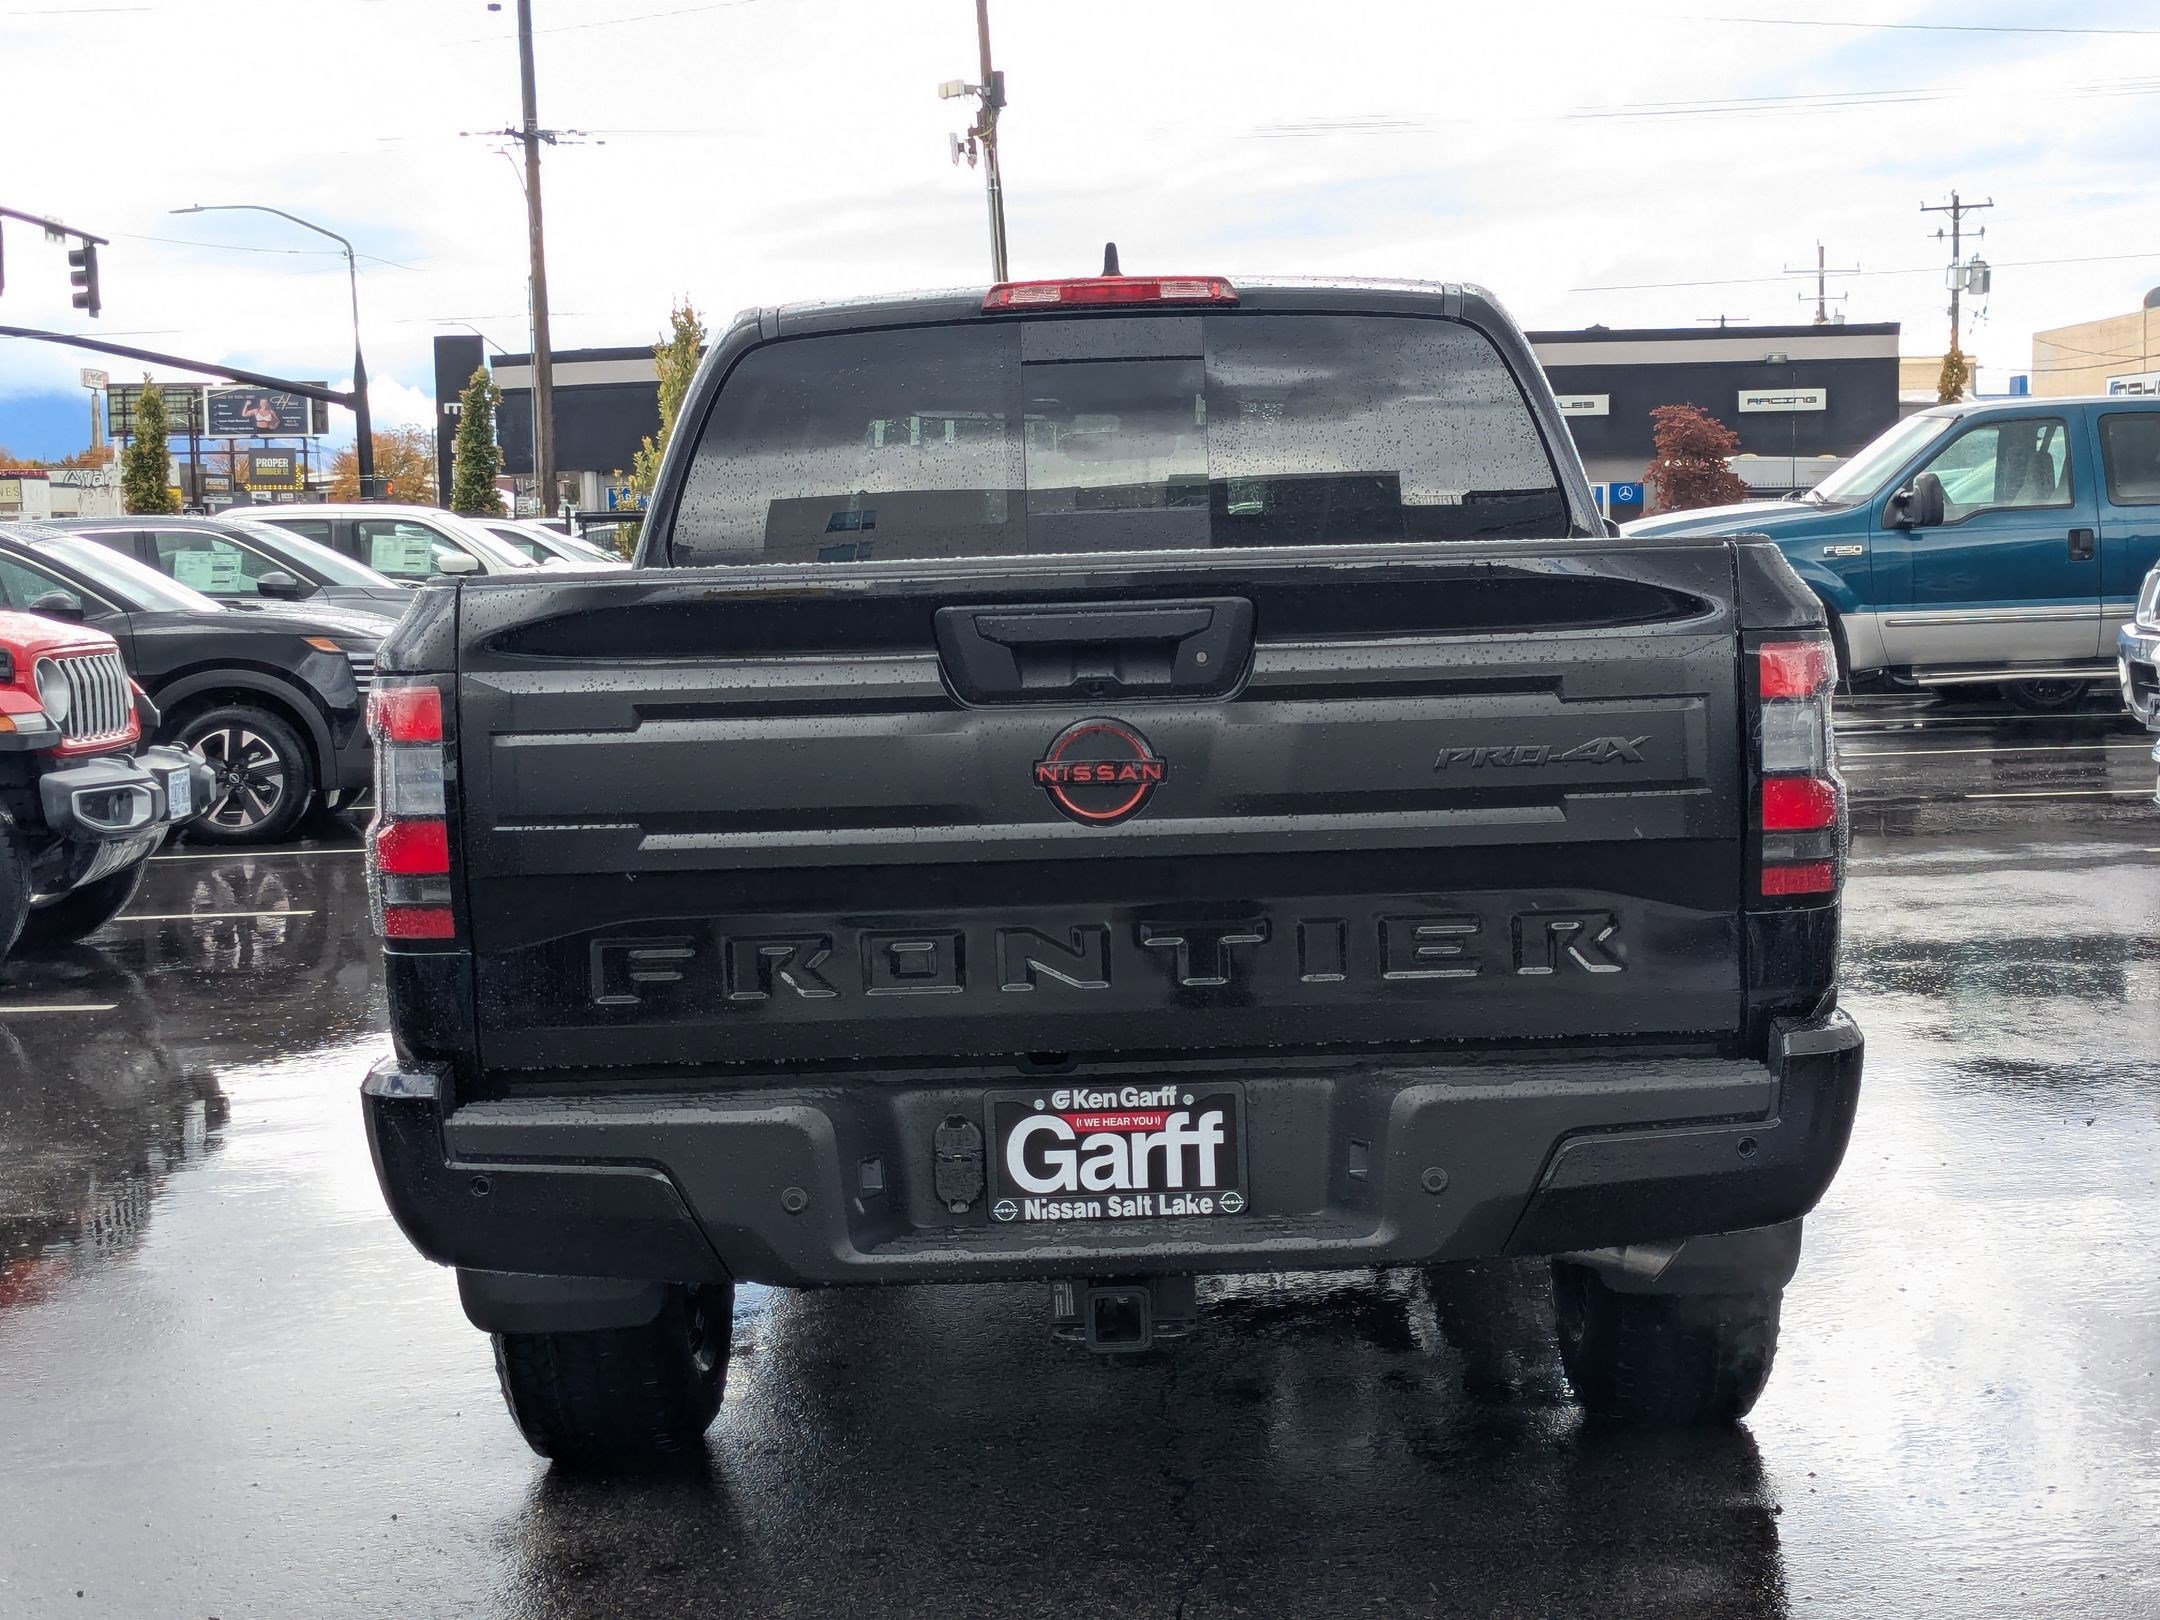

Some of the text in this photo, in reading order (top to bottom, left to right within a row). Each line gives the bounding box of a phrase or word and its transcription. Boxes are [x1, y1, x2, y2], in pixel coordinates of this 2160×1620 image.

[1746, 396, 1818, 406] RACING
[255, 458, 289, 468] PROPER
[1433, 736, 1653, 769] PRO-4X
[1038, 763, 1162, 782] NISSAN
[590, 908, 1629, 1004] FRONTIER
[1073, 1089, 1116, 1109] Ken
[1120, 1086, 1177, 1108] Garff
[1084, 1116, 1153, 1127] WE HEAR YOU
[1006, 1110, 1224, 1193] Garff
[1024, 1193, 1214, 1220] Nissan Salt Lake
